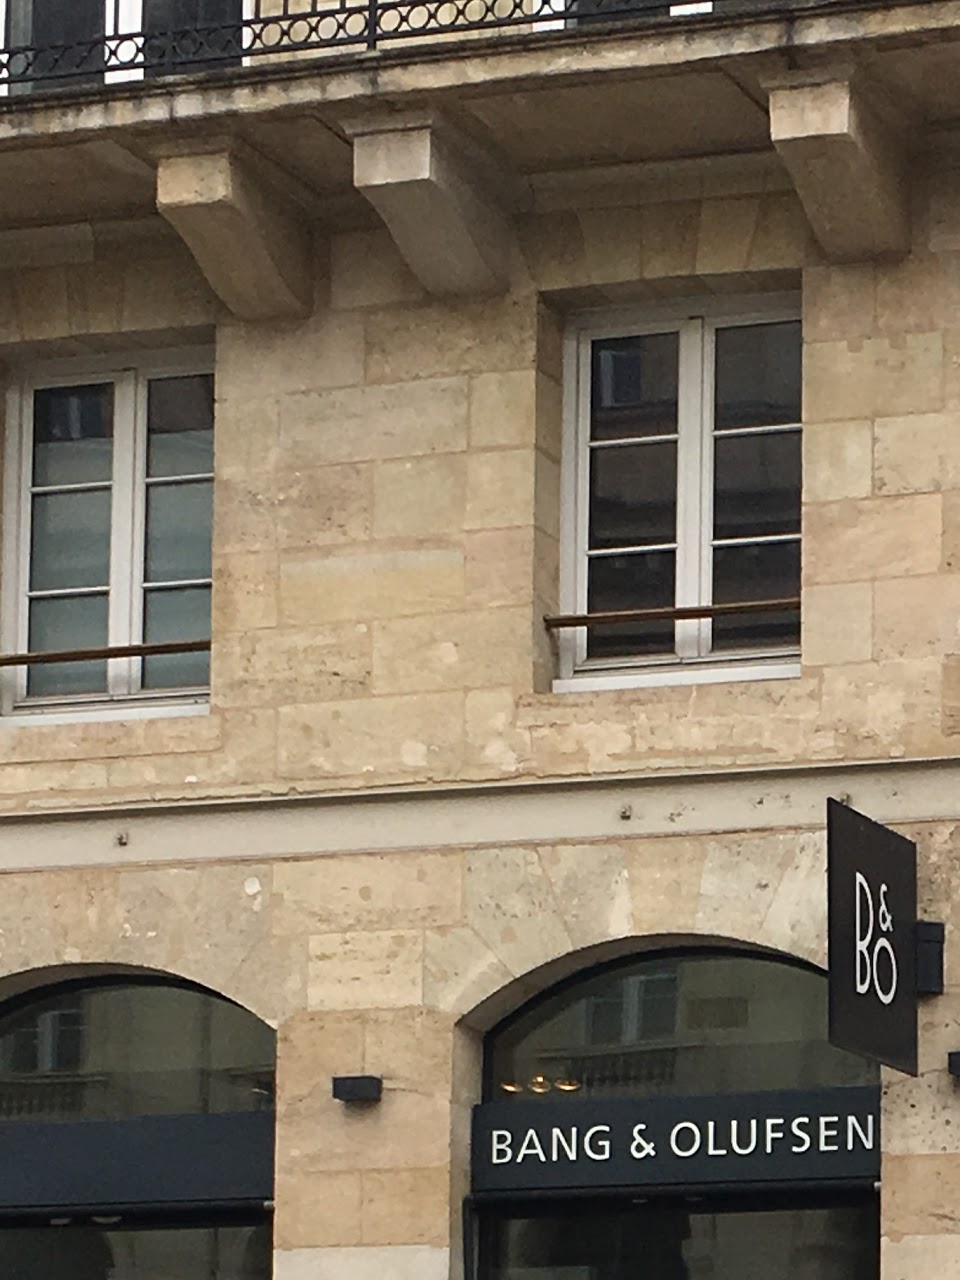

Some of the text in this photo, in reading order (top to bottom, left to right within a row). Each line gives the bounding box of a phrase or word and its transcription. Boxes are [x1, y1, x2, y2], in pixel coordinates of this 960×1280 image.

[491, 1114, 874, 1164] BANG & OLUFSEN
